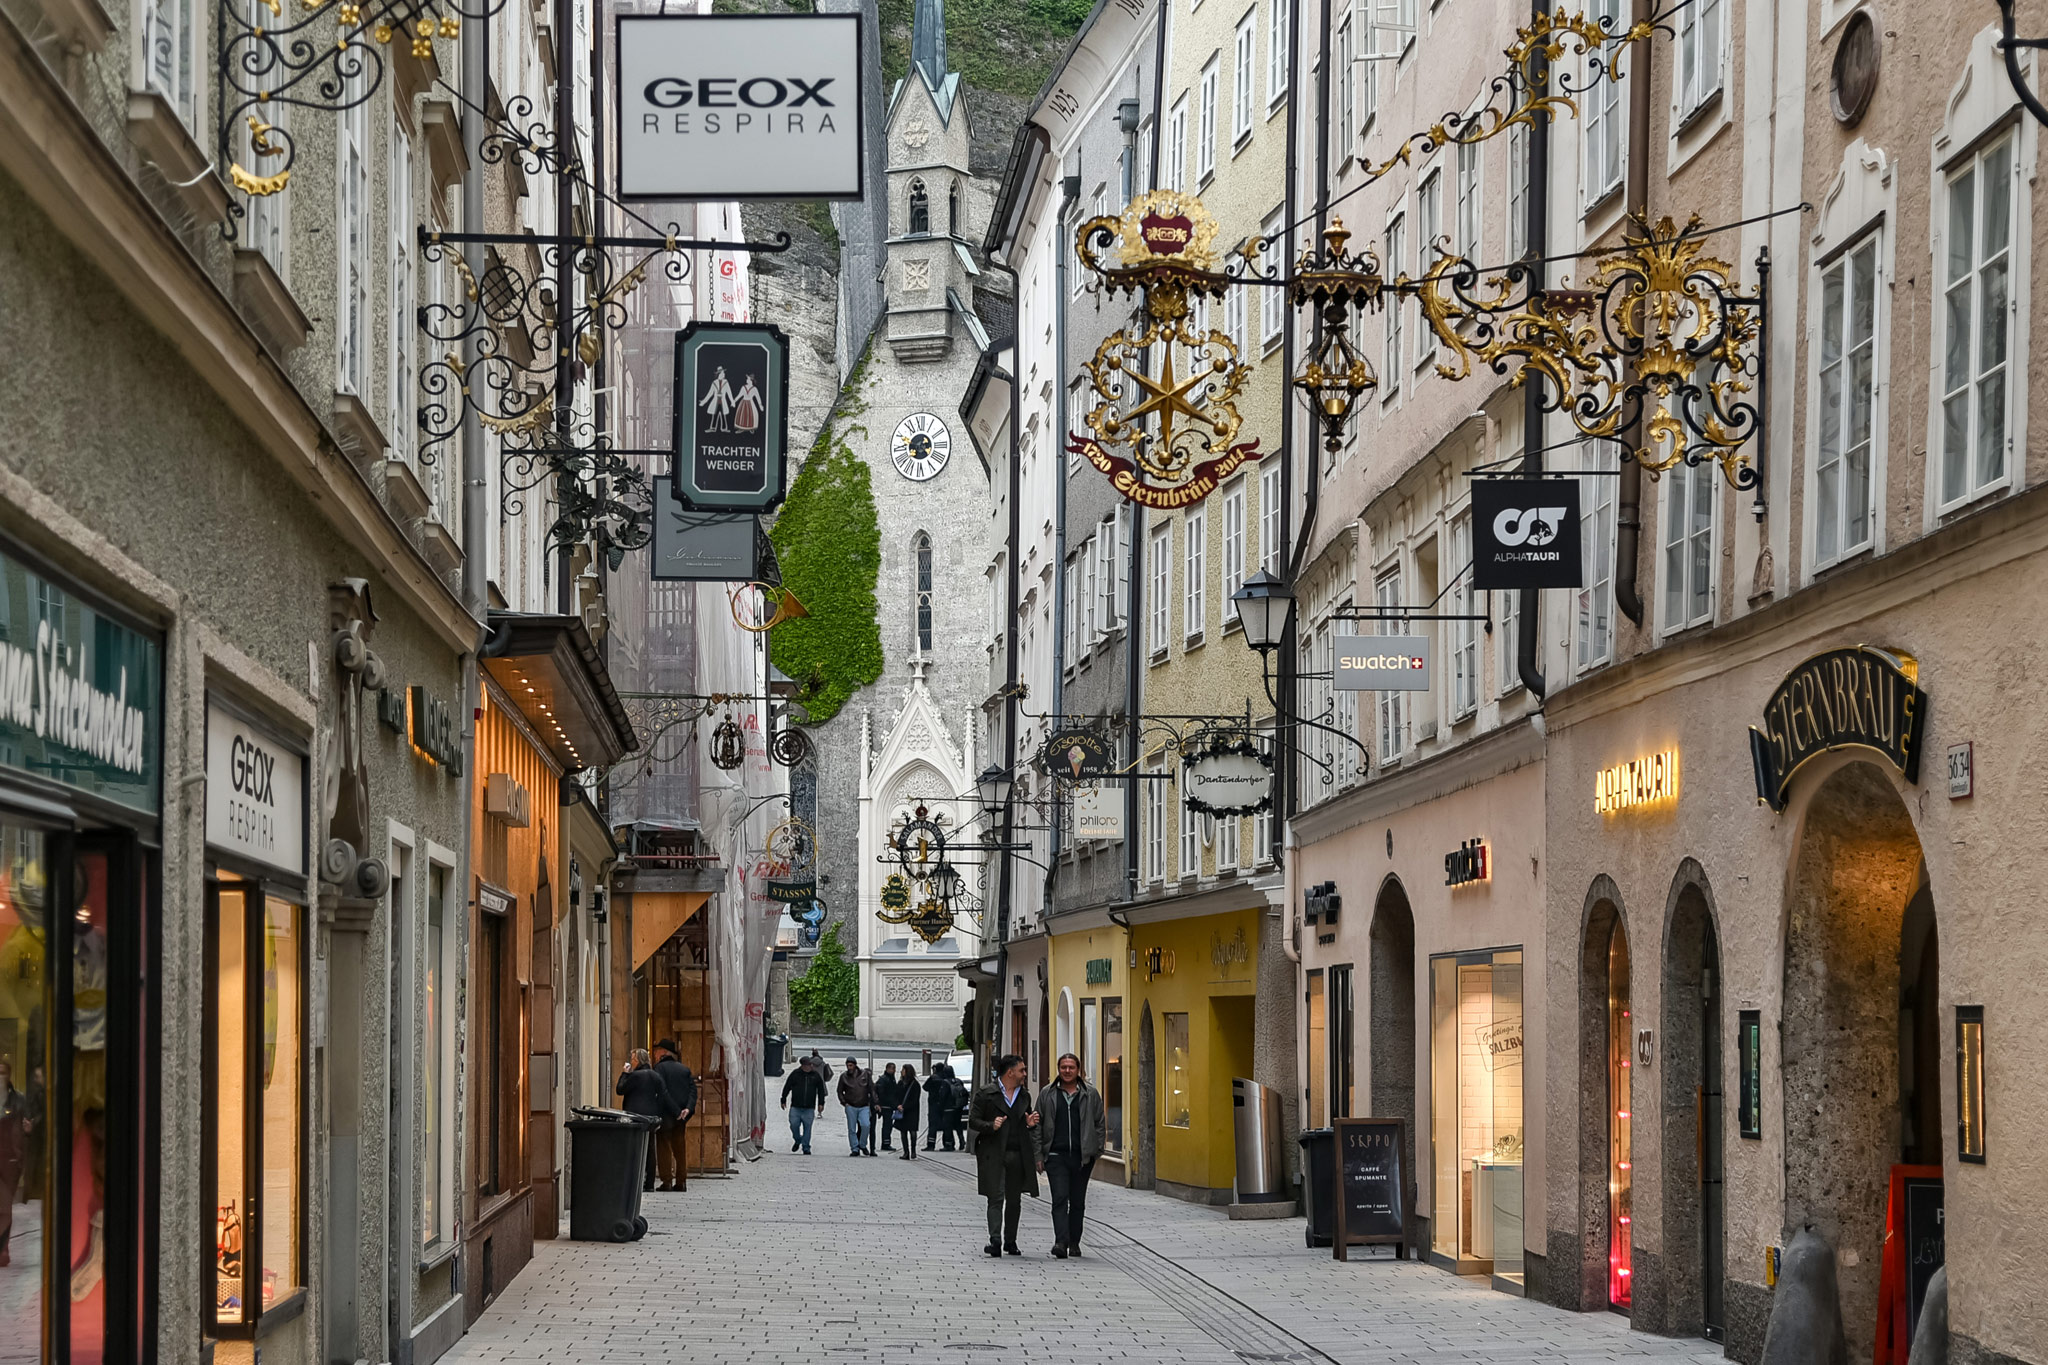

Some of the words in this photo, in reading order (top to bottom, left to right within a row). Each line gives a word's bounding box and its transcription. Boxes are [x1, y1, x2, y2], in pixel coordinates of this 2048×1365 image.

[643, 77, 836, 109] GEOX
[643, 113, 836, 134] RESPIRA
[701, 445, 760, 457] TRACHTEN
[706, 460, 755, 471] WENGER
[1082, 442, 1113, 472] 1720
[1114, 469, 1214, 507] Sternbräu
[1214, 447, 1246, 478] 2014
[1493, 551, 1560, 562] ALPHATAURI
[1340, 654, 1410, 670] swatch
[231, 734, 275, 808] GEOX
[1057, 766, 1071, 774] seit
[1082, 766, 1098, 774] 1958
[1194, 774, 1265, 786] Dantendorfer
[1595, 750, 1673, 814] ALPHATAURI
[229, 799, 275, 852] RESPIRA
[1080, 815, 1119, 828] philoro
[900, 821, 943, 841] SALAMANDER
[771, 886, 813, 898] STASSNY
[1350, 1134, 1390, 1149] SEPPO
